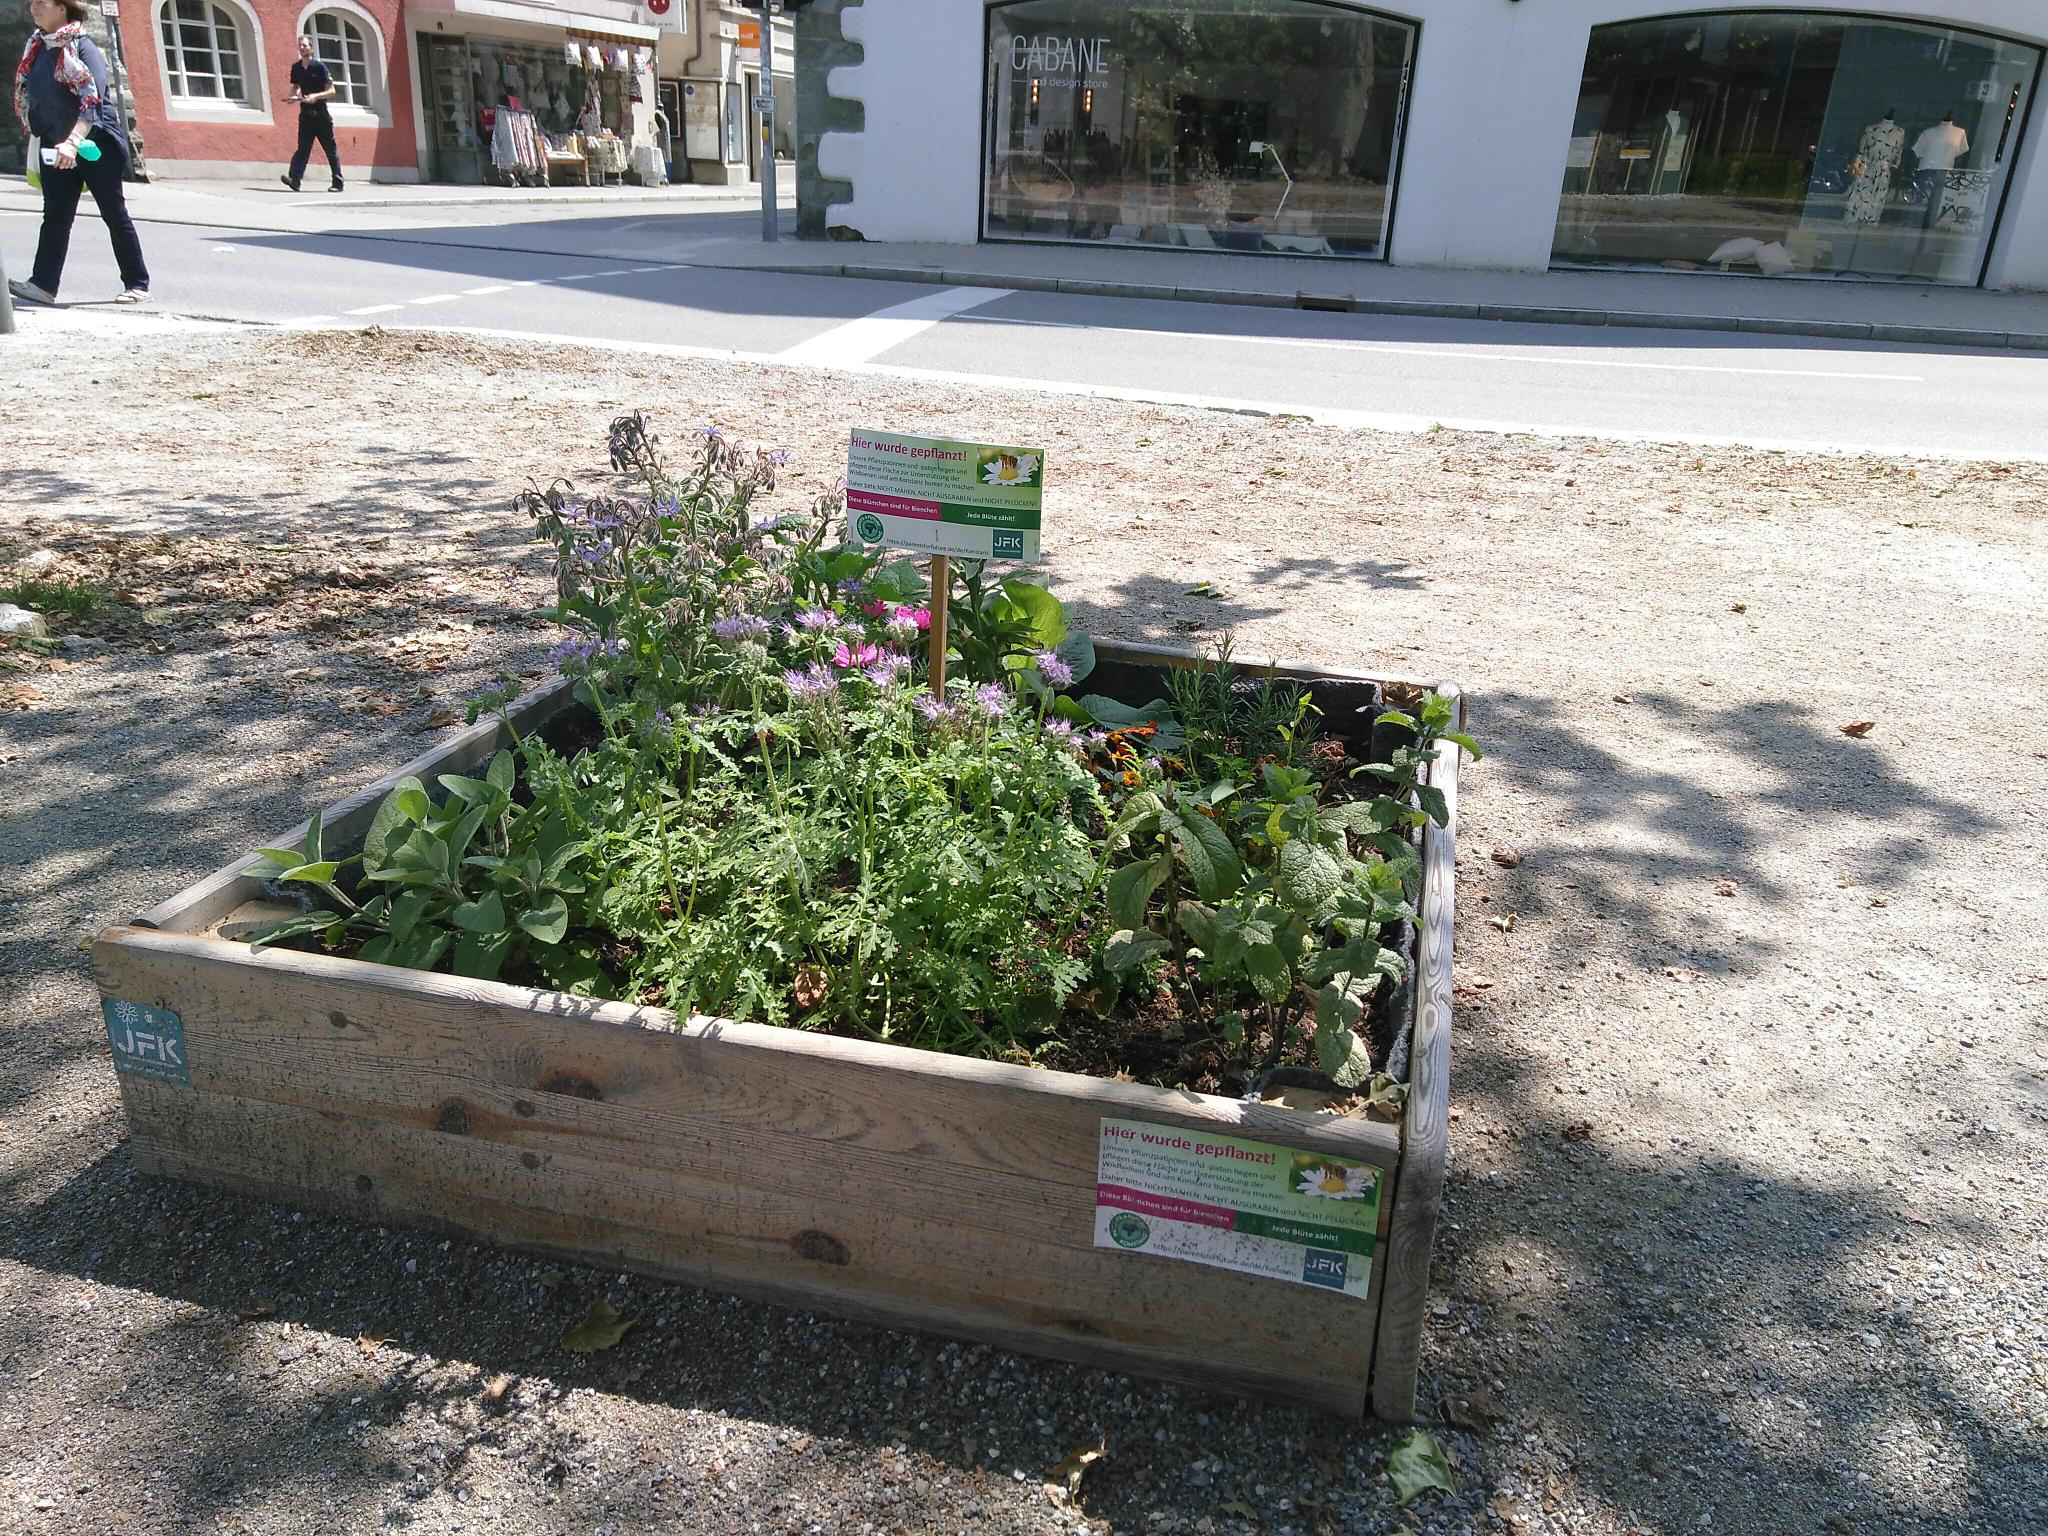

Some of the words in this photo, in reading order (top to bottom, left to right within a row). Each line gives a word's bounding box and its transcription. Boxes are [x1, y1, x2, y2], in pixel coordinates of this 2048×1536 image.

[1012, 35, 1110, 74] CABANE
[1050, 77, 1080, 90] design
[1083, 78, 1108, 89] store
[851, 436, 872, 449] Hier
[874, 443, 908, 454] wurde
[911, 448, 967, 462] gepflanzt!
[848, 468, 877, 480] Wildbienen
[878, 472, 888, 480] und
[900, 476, 924, 486] Konstanz
[924, 480, 943, 488] bunter
[849, 461, 868, 470] pflegen
[868, 464, 882, 472] diese
[907, 461, 918, 469] und
[956, 468, 968, 476] und
[848, 480, 863, 488] Daher
[864, 482, 876, 490] bitte
[877, 484, 894, 492] NICHT
[918, 490, 936, 498] NICHT
[936, 492, 972, 502] AUSGRABEN
[848, 495, 862, 504] Diese
[862, 498, 888, 508] Blümchen
[890, 502, 902, 510] sind
[912, 505, 938, 514] Bienchen
[994, 536, 1020, 548] JFK
[118, 1030, 182, 1064] JFK
[1104, 1126, 1136, 1140] Hier
[1141, 1132, 1191, 1150] wurde
[1195, 1143, 1276, 1165] gepflanzt!
[1102, 1153, 1130, 1163] pflegen
[1131, 1158, 1152, 1167] diese
[1250, 1180, 1264, 1188] der
[1103, 1144, 1129, 1154] Unsere
[1190, 1160, 1205, 1169] und
[1208, 1165, 1232, 1174] paten
[1234, 1167, 1258, 1179] hegen
[1102, 1160, 1144, 1175] Wildbienen
[1146, 1168, 1161, 1178] und
[1177, 1174, 1212, 1189] Konstanz
[1214, 1183, 1239, 1193] bunter
[1100, 1190, 1120, 1200] Diese
[1162, 1202, 1178, 1212] sind
[1180, 1205, 1192, 1214] für
[1102, 1172, 1124, 1182] Daher
[1125, 1176, 1142, 1186] bitte
[1144, 1181, 1168, 1192] NICHT
[1204, 1194, 1227, 1204] NICHT
[1230, 1200, 1278, 1213] AUSGRABEN
[1280, 1208, 1296, 1216] und
[1299, 1210, 1322, 1220] NICHT
[1272, 1224, 1290, 1234] Jede
[1306, 1258, 1344, 1275] JFK
